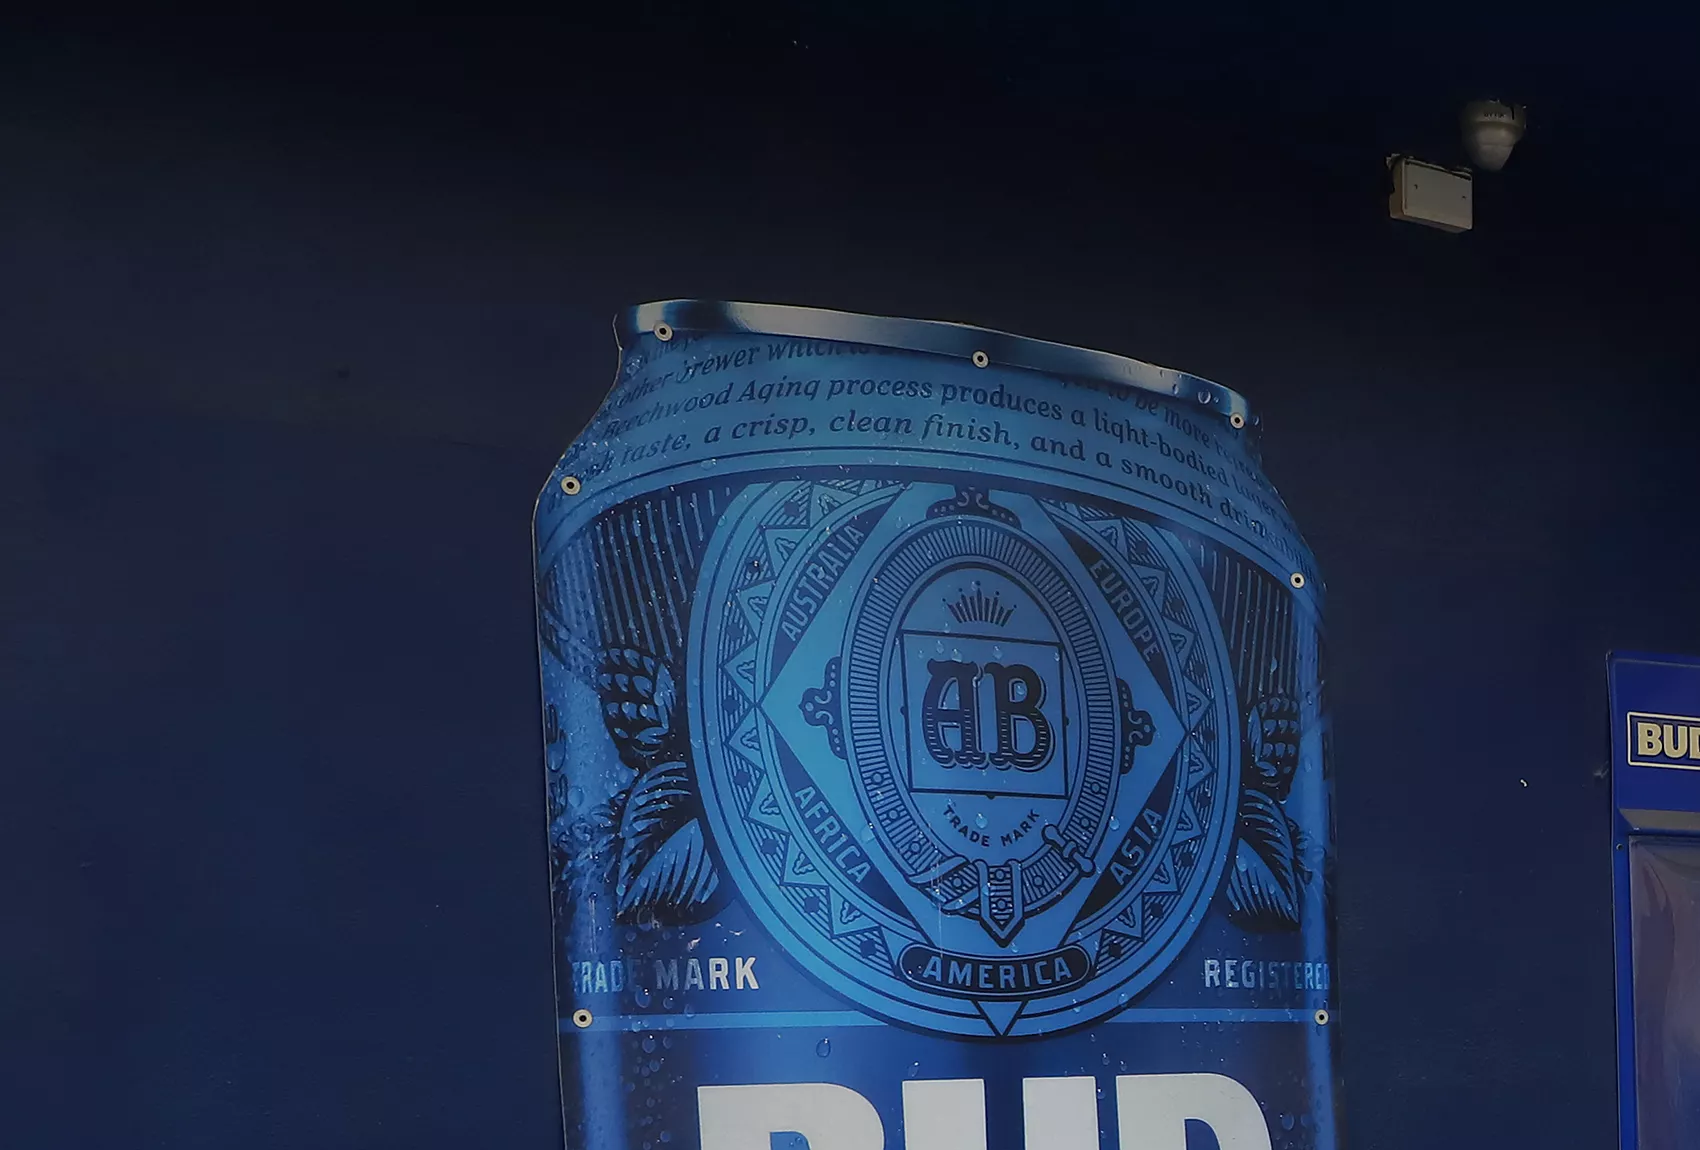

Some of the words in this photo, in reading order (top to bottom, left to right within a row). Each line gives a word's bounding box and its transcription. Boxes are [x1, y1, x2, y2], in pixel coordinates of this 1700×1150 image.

[703, 424, 721, 444] a
[731, 413, 816, 439] crisp,
[829, 409, 913, 433] clean
[921, 413, 1021, 450] finish,
[1030, 435, 1087, 462] and
[1095, 450, 1113, 469] a
[1120, 457, 1213, 510] smooth
[736, 375, 821, 404] Aging
[826, 378, 933, 400] process
[940, 383, 1063, 421] produces
[1070, 409, 1087, 427] a
[1094, 408, 1230, 487] light-bodied
[1164, 406, 1210, 448] more
[780, 524, 864, 642] AUSTRALIA
[1090, 558, 1160, 662] EUROPE
[794, 784, 873, 885] AFRICA
[944, 804, 990, 847] TRADE
[1000, 809, 1040, 847] MARK
[1110, 806, 1163, 888] ASIA
[655, 956, 760, 991] MARK
[922, 952, 1072, 990] AMERICA
